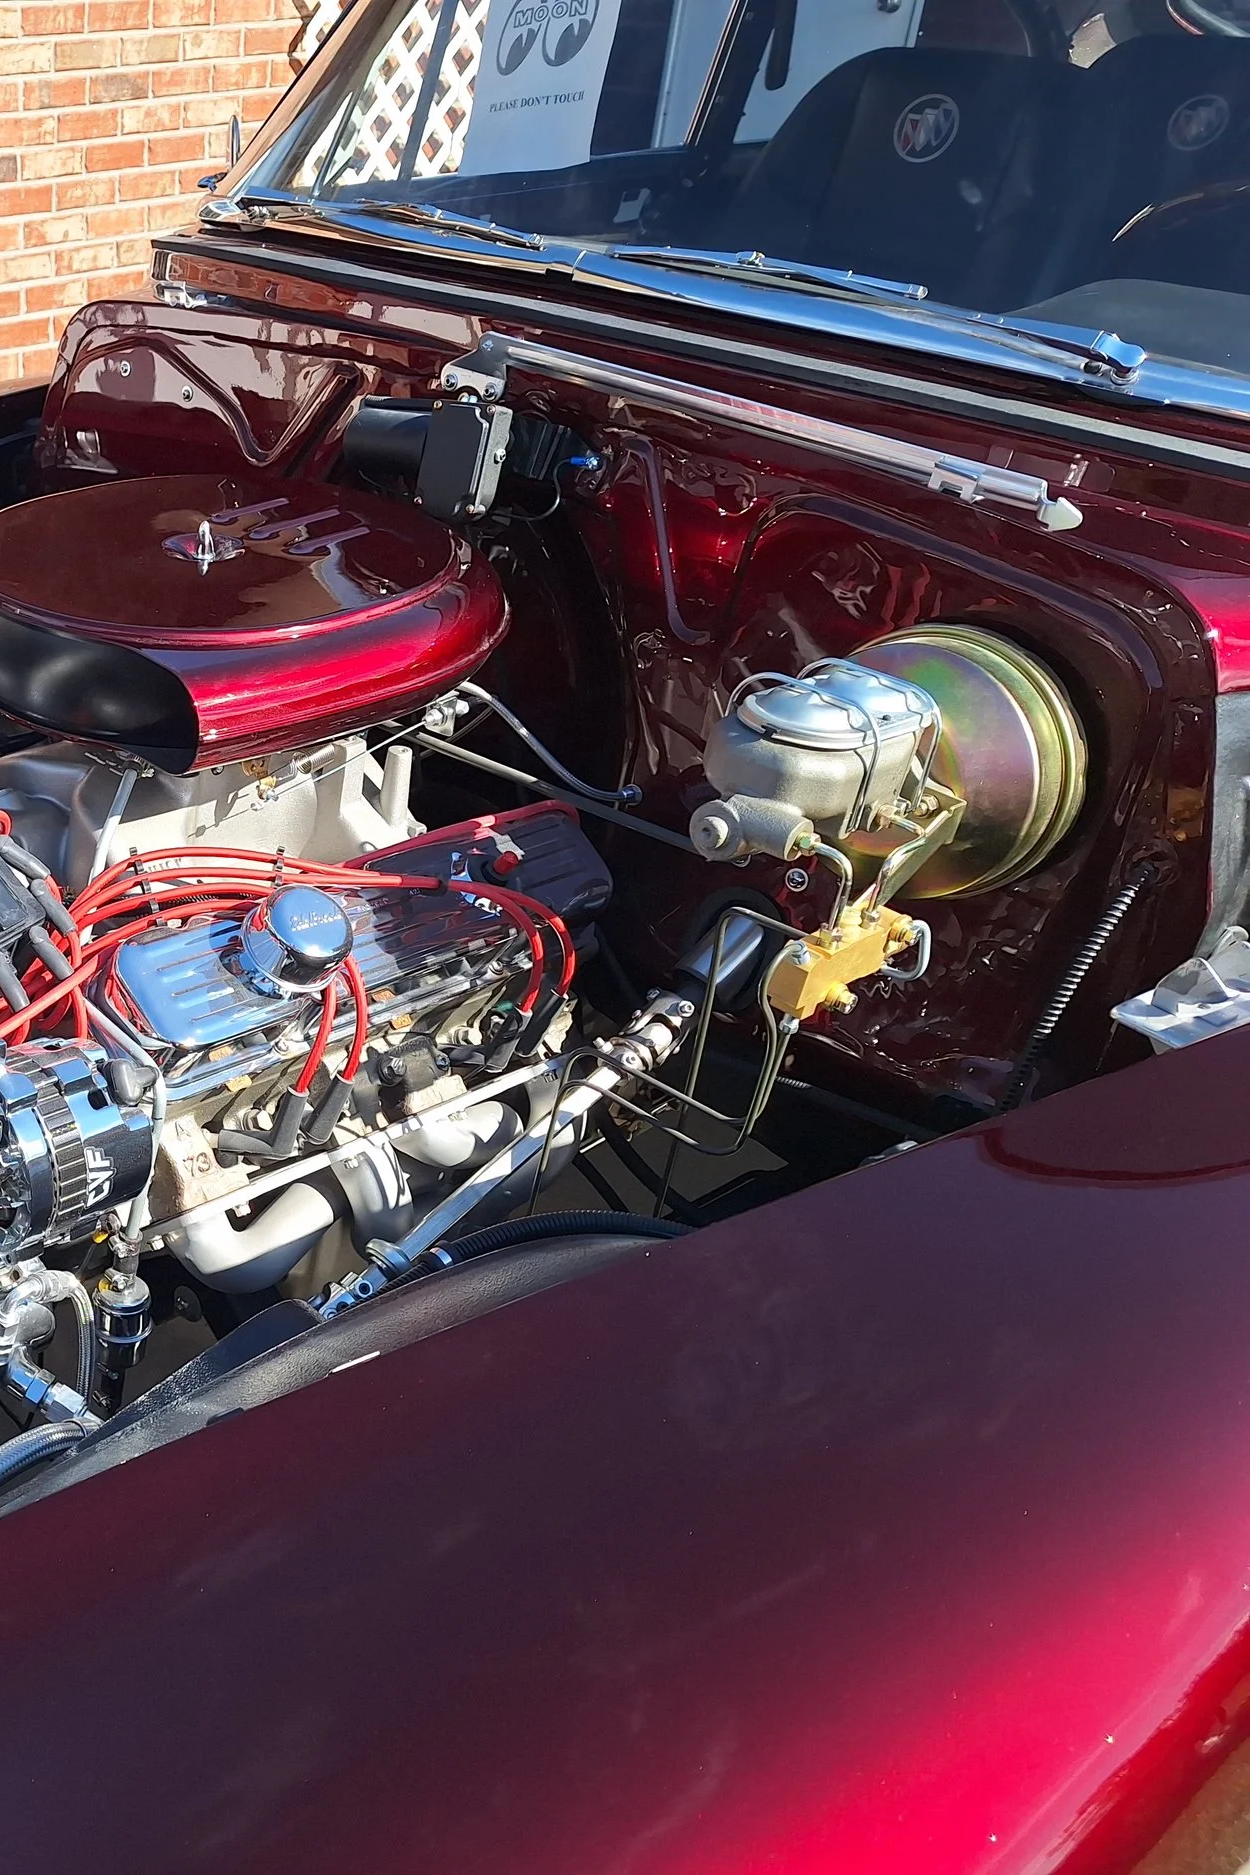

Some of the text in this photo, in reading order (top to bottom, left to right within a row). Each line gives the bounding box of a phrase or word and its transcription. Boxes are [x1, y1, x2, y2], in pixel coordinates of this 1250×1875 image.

[513, 0, 588, 28] MOON
[490, 90, 585, 113] PLEASE DON'T TOUCH
[84, 1146, 117, 1209] CVF
